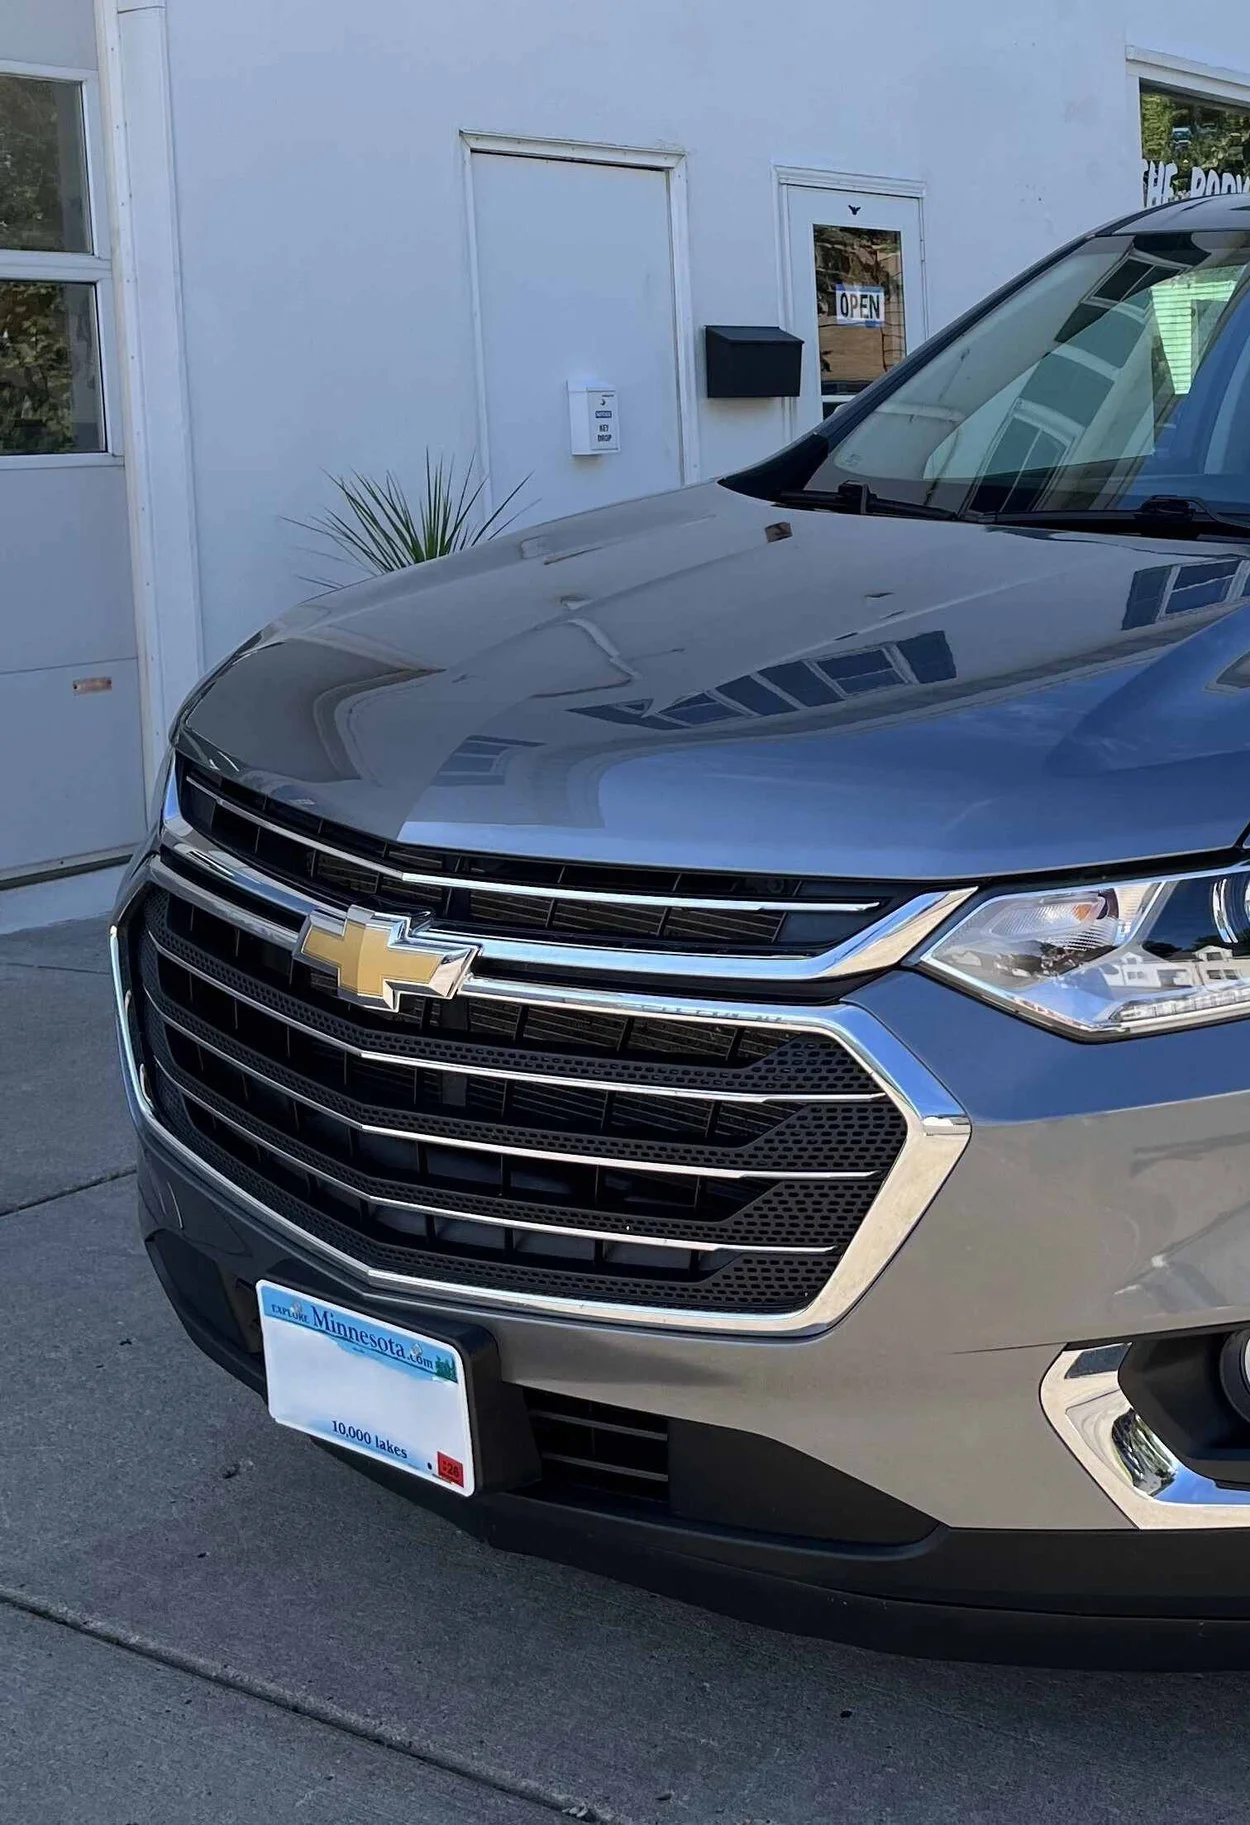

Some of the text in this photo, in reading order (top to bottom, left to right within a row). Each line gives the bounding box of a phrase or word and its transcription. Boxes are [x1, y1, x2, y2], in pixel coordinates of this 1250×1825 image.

[840, 292, 880, 320] OPEN
[332, 1420, 408, 1459] 10,000 lakes
